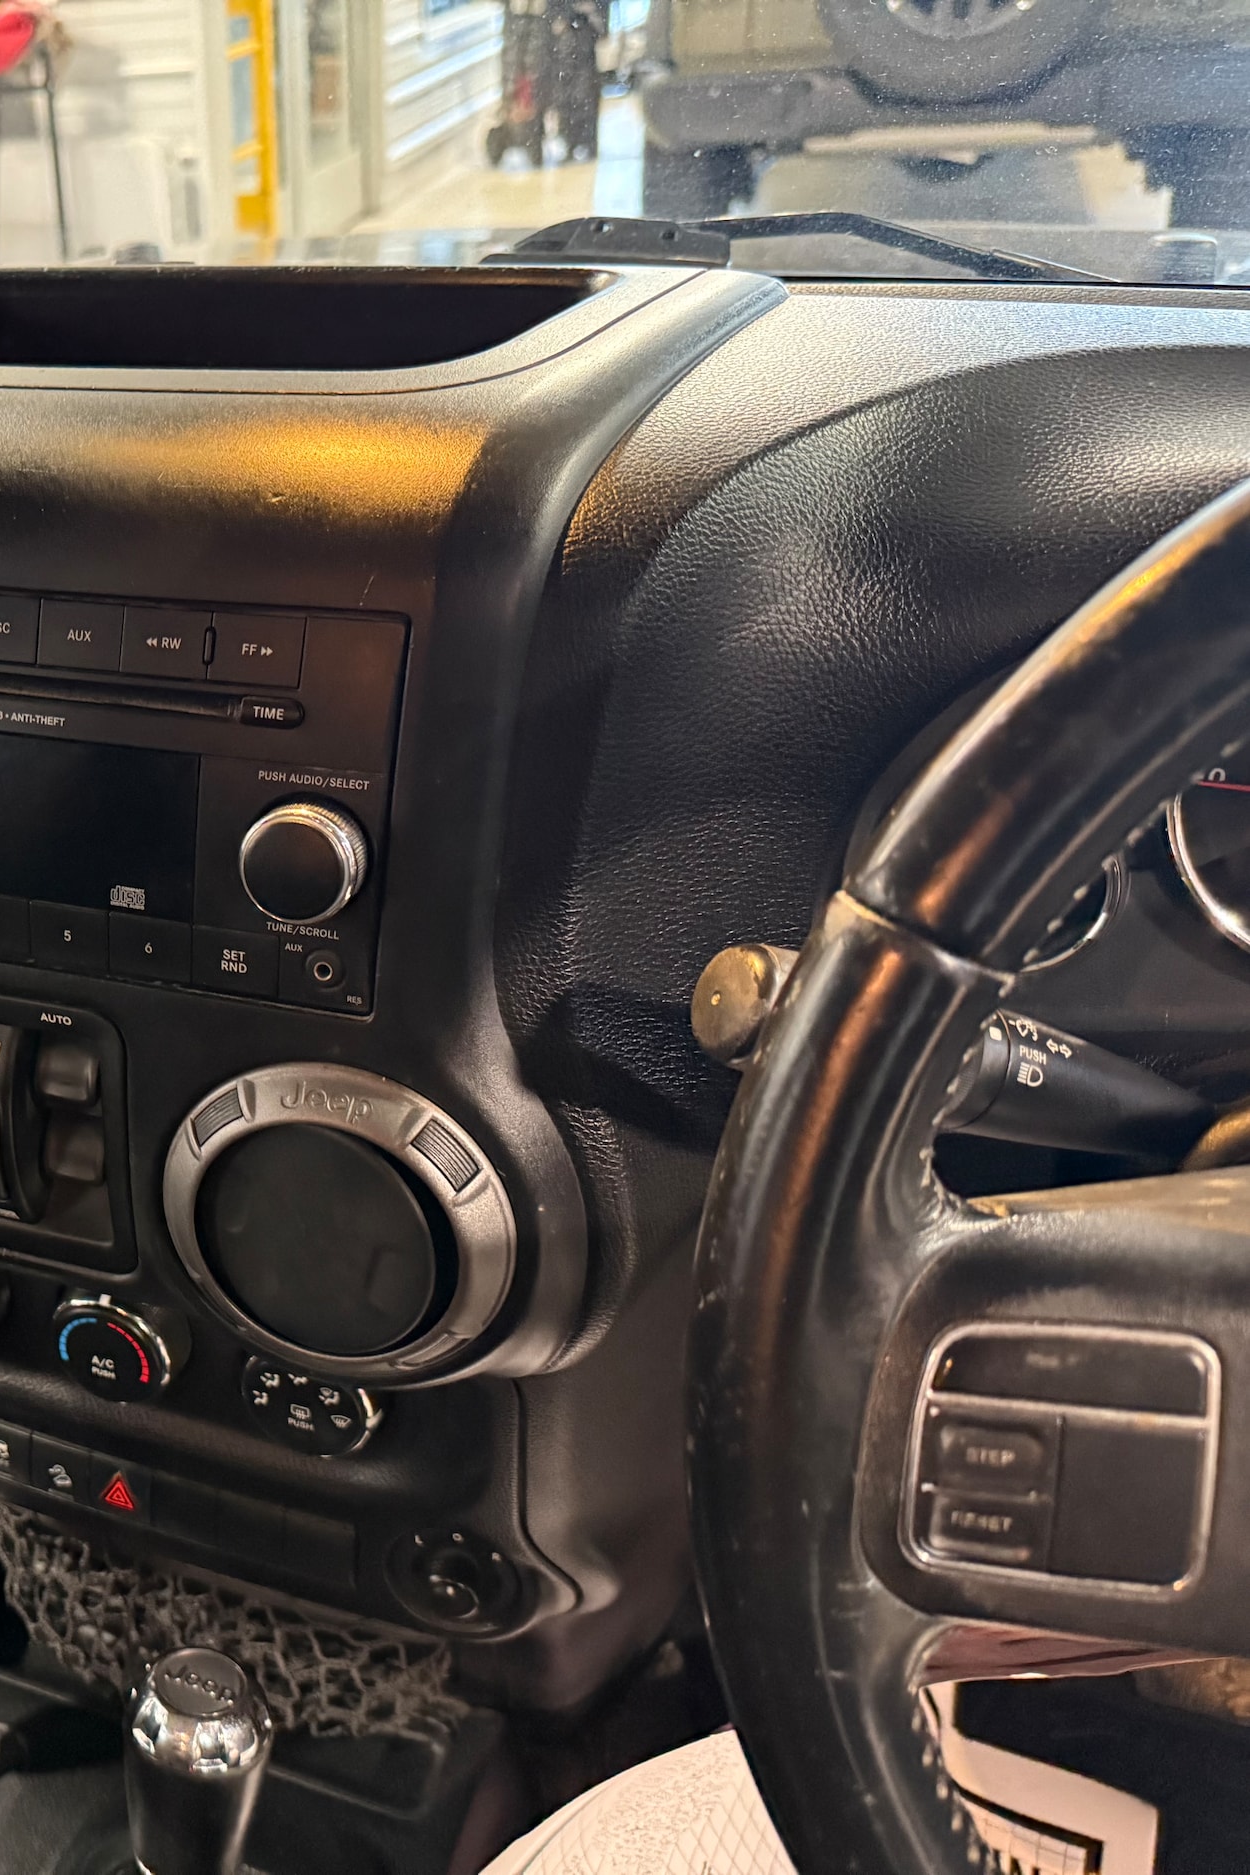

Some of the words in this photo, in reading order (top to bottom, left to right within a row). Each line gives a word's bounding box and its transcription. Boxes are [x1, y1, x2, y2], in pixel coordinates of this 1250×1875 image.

[67, 628, 92, 642] AUX
[161, 636, 182, 650] RW
[241, 643, 258, 656] FF
[10, 712, 66, 727] ANTI-THEFT
[252, 705, 285, 721] TIME
[258, 770, 287, 782] PUSH
[288, 773, 370, 791] AUDIO/SELECT
[63, 929, 72, 942] 5
[266, 921, 340, 940] TUNE/SCROLL
[144, 942, 153, 954] 6
[284, 942, 303, 953] AUX
[222, 948, 246, 962] SET
[220, 960, 248, 974] RND
[40, 1012, 72, 1026] AUTO
[1019, 1044, 1047, 1065] PUSH
[280, 1079, 373, 1126] Jeep
[91, 1355, 115, 1370] A/C
[287, 1416, 315, 1432] PUSH
